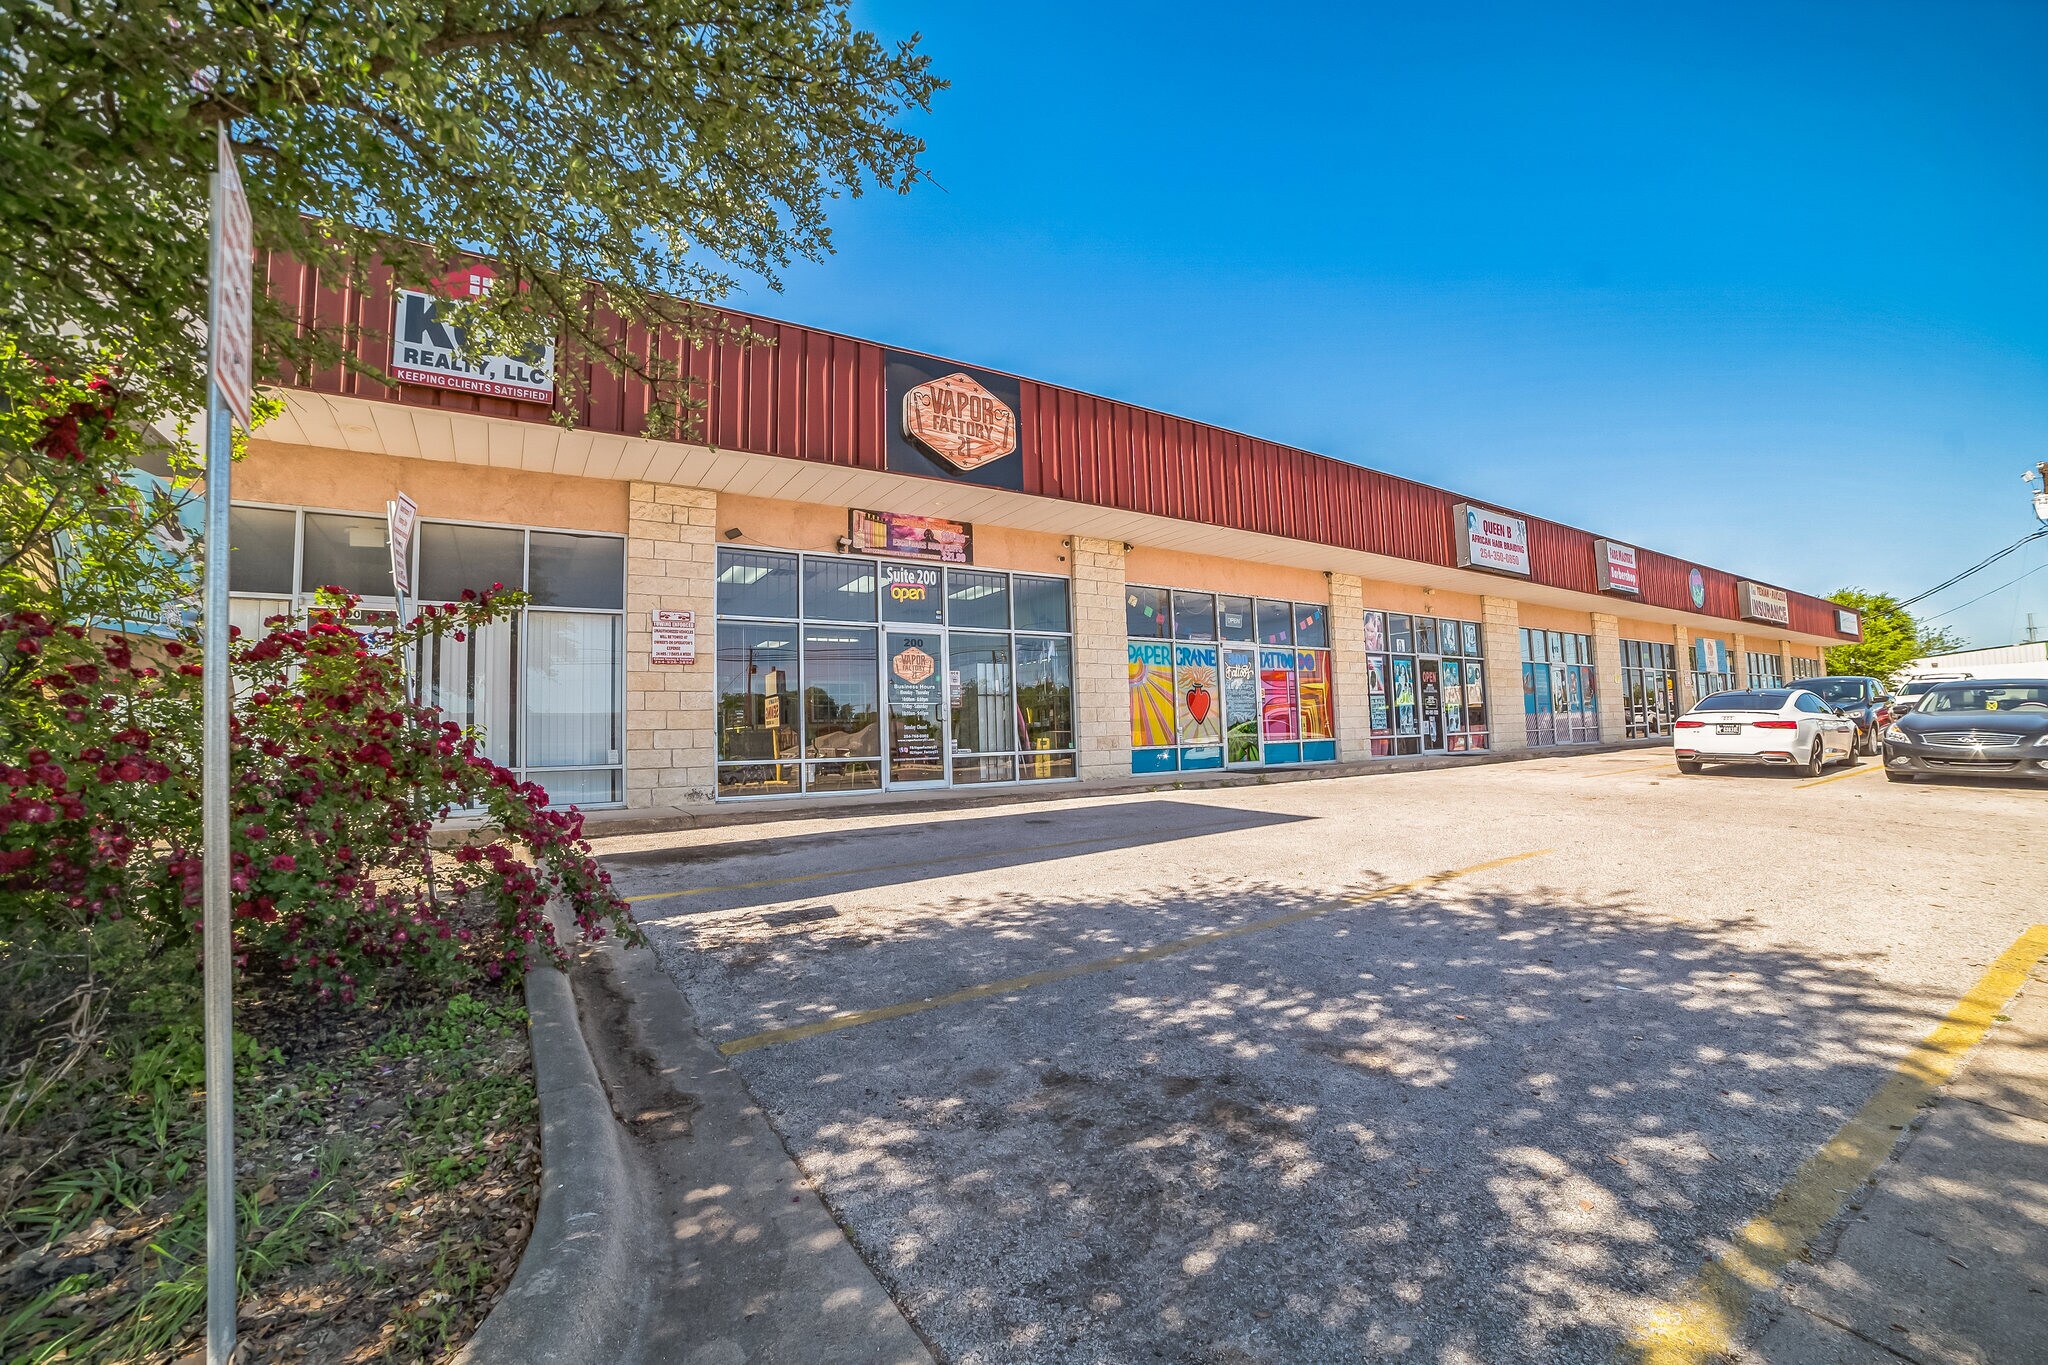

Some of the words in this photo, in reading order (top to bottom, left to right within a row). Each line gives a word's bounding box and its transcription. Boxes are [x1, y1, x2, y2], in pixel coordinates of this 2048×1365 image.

[404, 347, 496, 380] REALTY,
[504, 364, 545, 384] LLC
[397, 370, 445, 385] KEEPING
[448, 377, 491, 392] CLIENTS
[494, 385, 548, 401] SATISFIED!
[930, 386, 994, 424] VAPOR
[933, 415, 993, 439] FACTORY
[957, 436, 971, 457] 21
[1482, 519, 1505, 537] QUEEN
[1506, 526, 1512, 538] B
[1471, 534, 1491, 546] AFRICAN
[1492, 539, 1503, 549] HAIR
[1503, 541, 1525, 553] BRAIDING
[886, 566, 915, 584] Suite
[916, 569, 937, 586] 200
[890, 587, 926, 603] open
[1751, 599, 1788, 622] INSURANCE
[1226, 616, 1242, 626] OPEN
[903, 638, 924, 648] 200
[901, 654, 926, 666] VAPOR
[1128, 644, 1172, 666] PAPER
[1175, 647, 1216, 667] CRANE
[1422, 671, 1437, 682] OPEN
